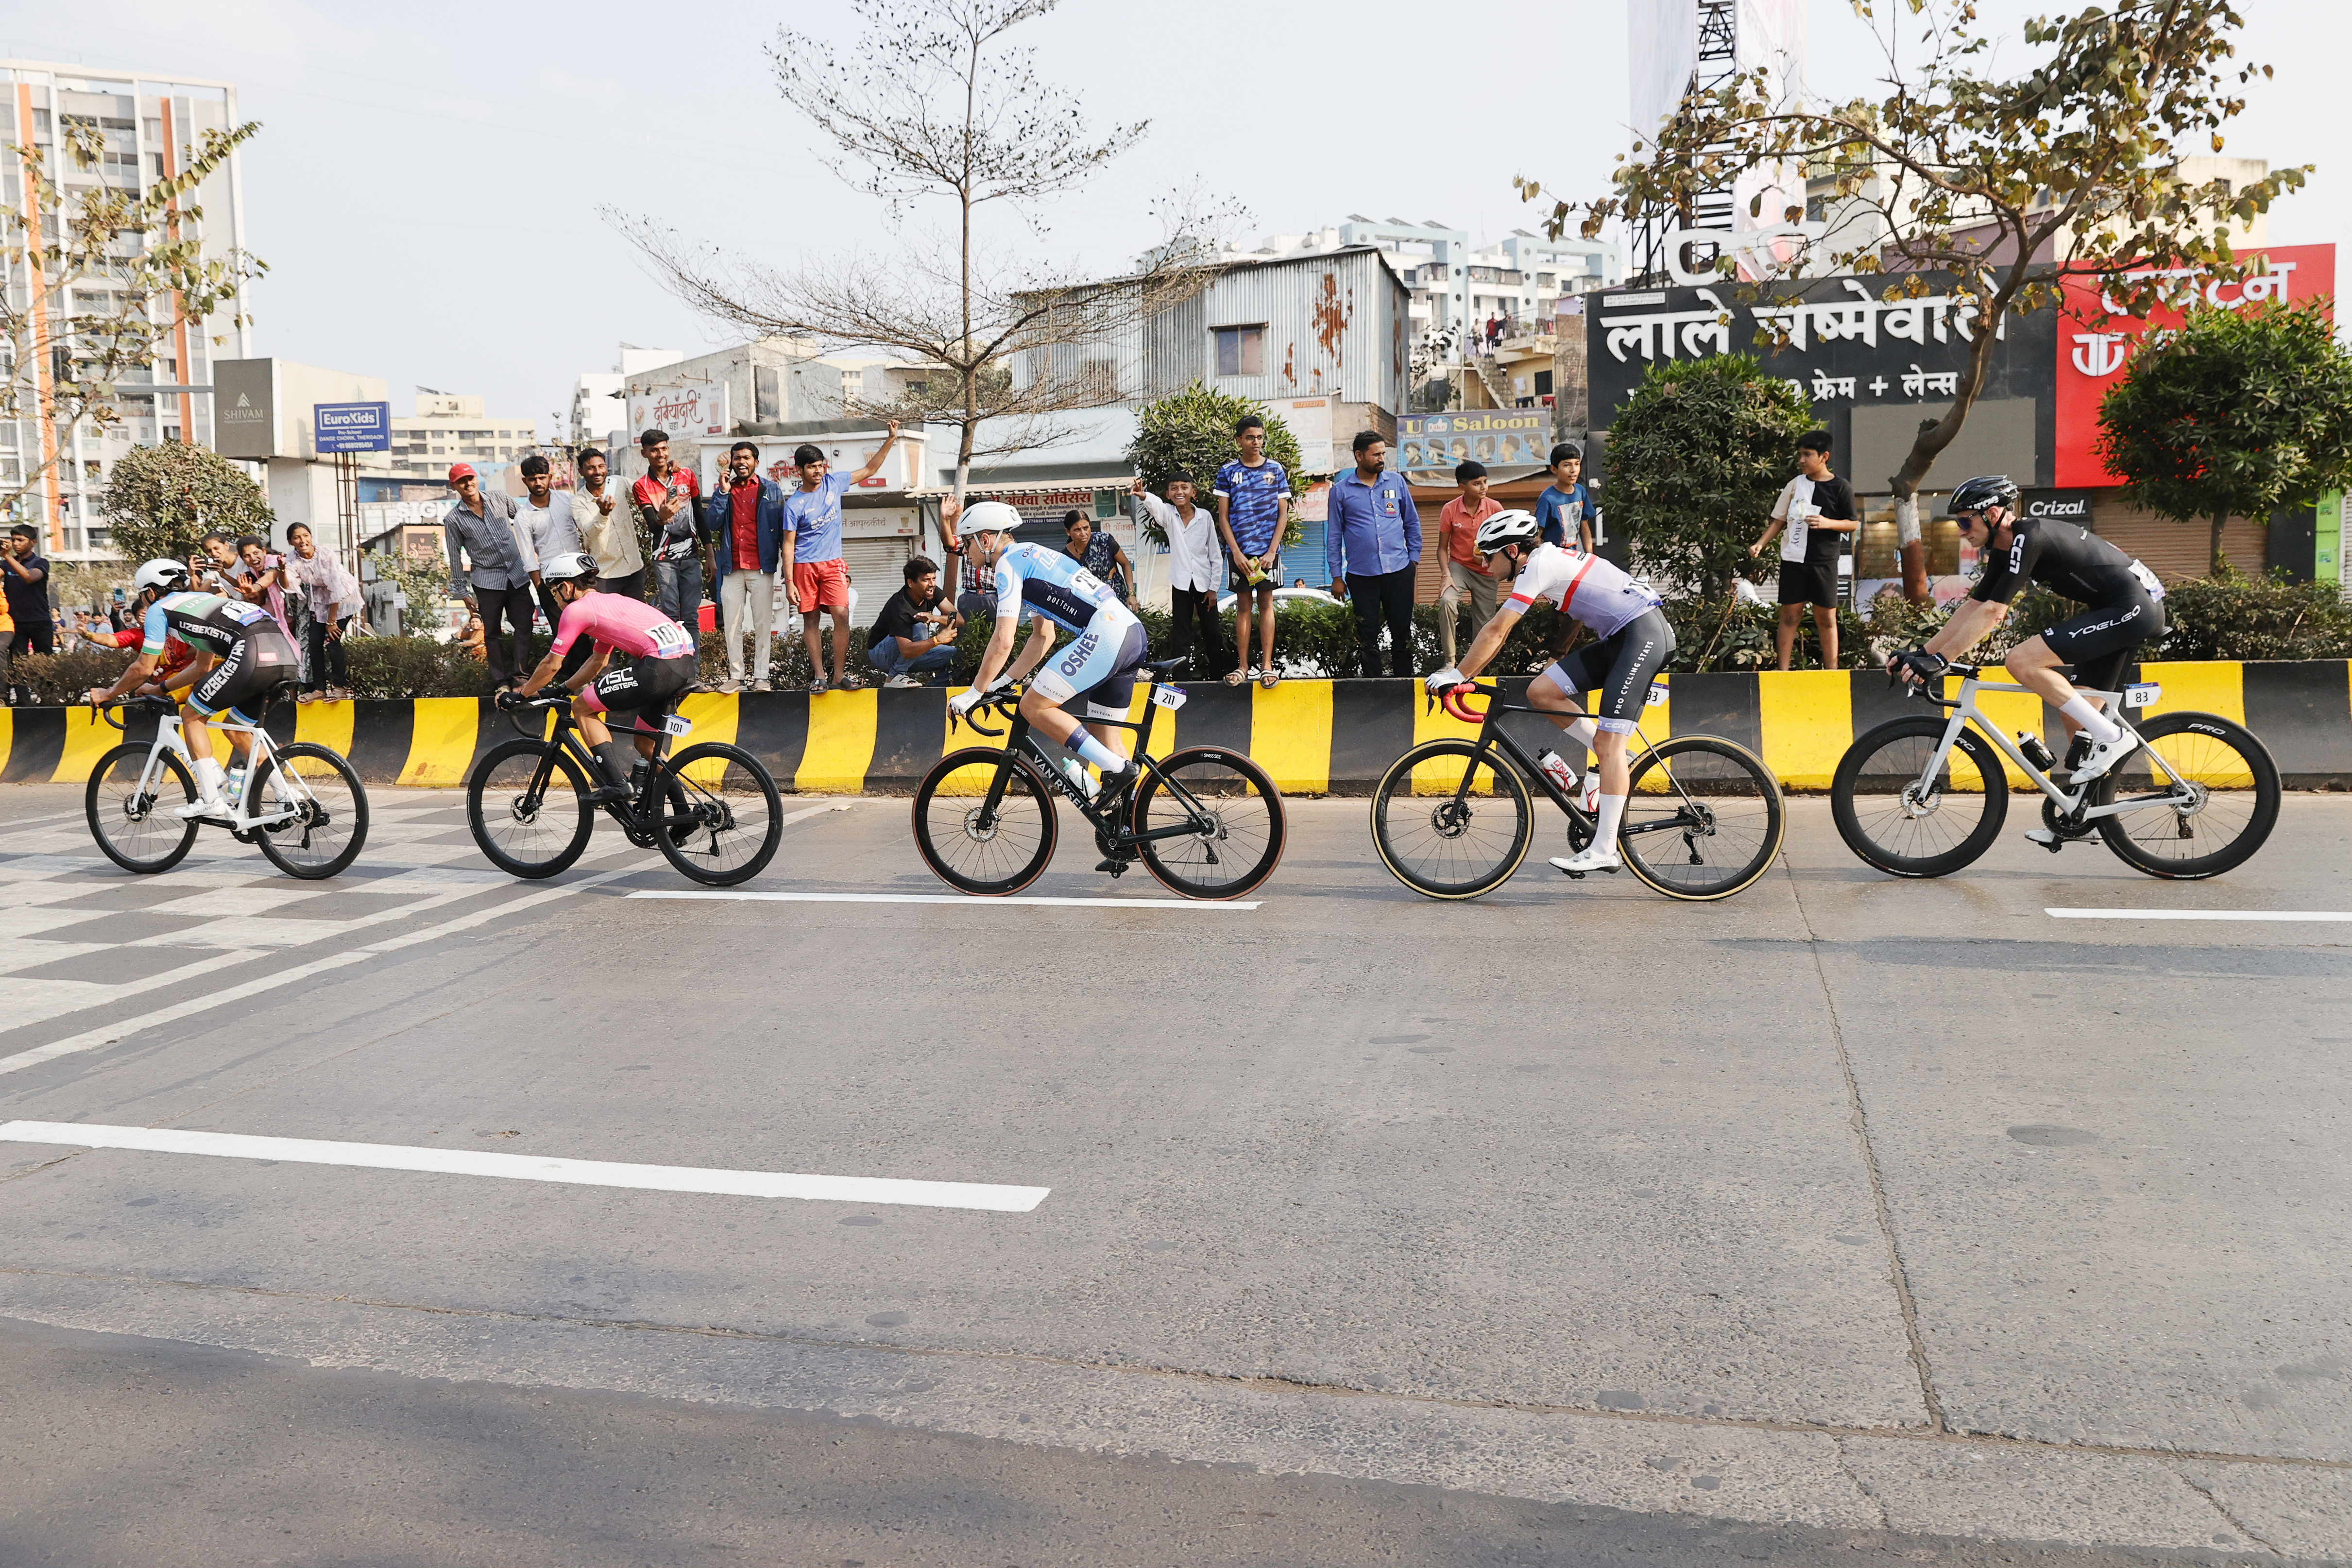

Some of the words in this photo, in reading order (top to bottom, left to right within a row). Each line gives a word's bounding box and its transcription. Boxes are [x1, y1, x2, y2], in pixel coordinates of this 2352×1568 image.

[1901, 363, 1959, 397] लेन्स
[223, 409, 264, 420] SHIVAM
[324, 412, 375, 425] EuroKids
[1405, 419, 1423, 434] U
[1452, 414, 1540, 432] Saloon
[1232, 472, 1243, 484] 41
[1266, 568, 1277, 583] 41
[1046, 595, 1078, 616] DOLTCINI
[2068, 605, 2141, 638] YOELEO
[179, 621, 233, 645] UZBEKISTAN
[1060, 632, 1100, 678] OSHEE
[197, 639, 246, 702] UZBEKISTAN
[1614, 697, 1624, 715] PRO
[1620, 662, 1641, 696] CYCLING
[1637, 640, 1654, 661] STATS
[599, 680, 639, 696] MONSTERS
[1043, 685, 1066, 699] DOLTCINI
[1162, 693, 1176, 705] 211
[2135, 692, 2148, 703] 83
[1091, 709, 1113, 717] DOLTCINI
[670, 722, 682, 733] 101
[2187, 723, 2226, 735] PRO
[1955, 737, 1976, 751] RO
[1012, 764, 1023, 774] SWISS
[1020, 769, 1028, 778] SIDE
[1033, 754, 1056, 779] VAN
